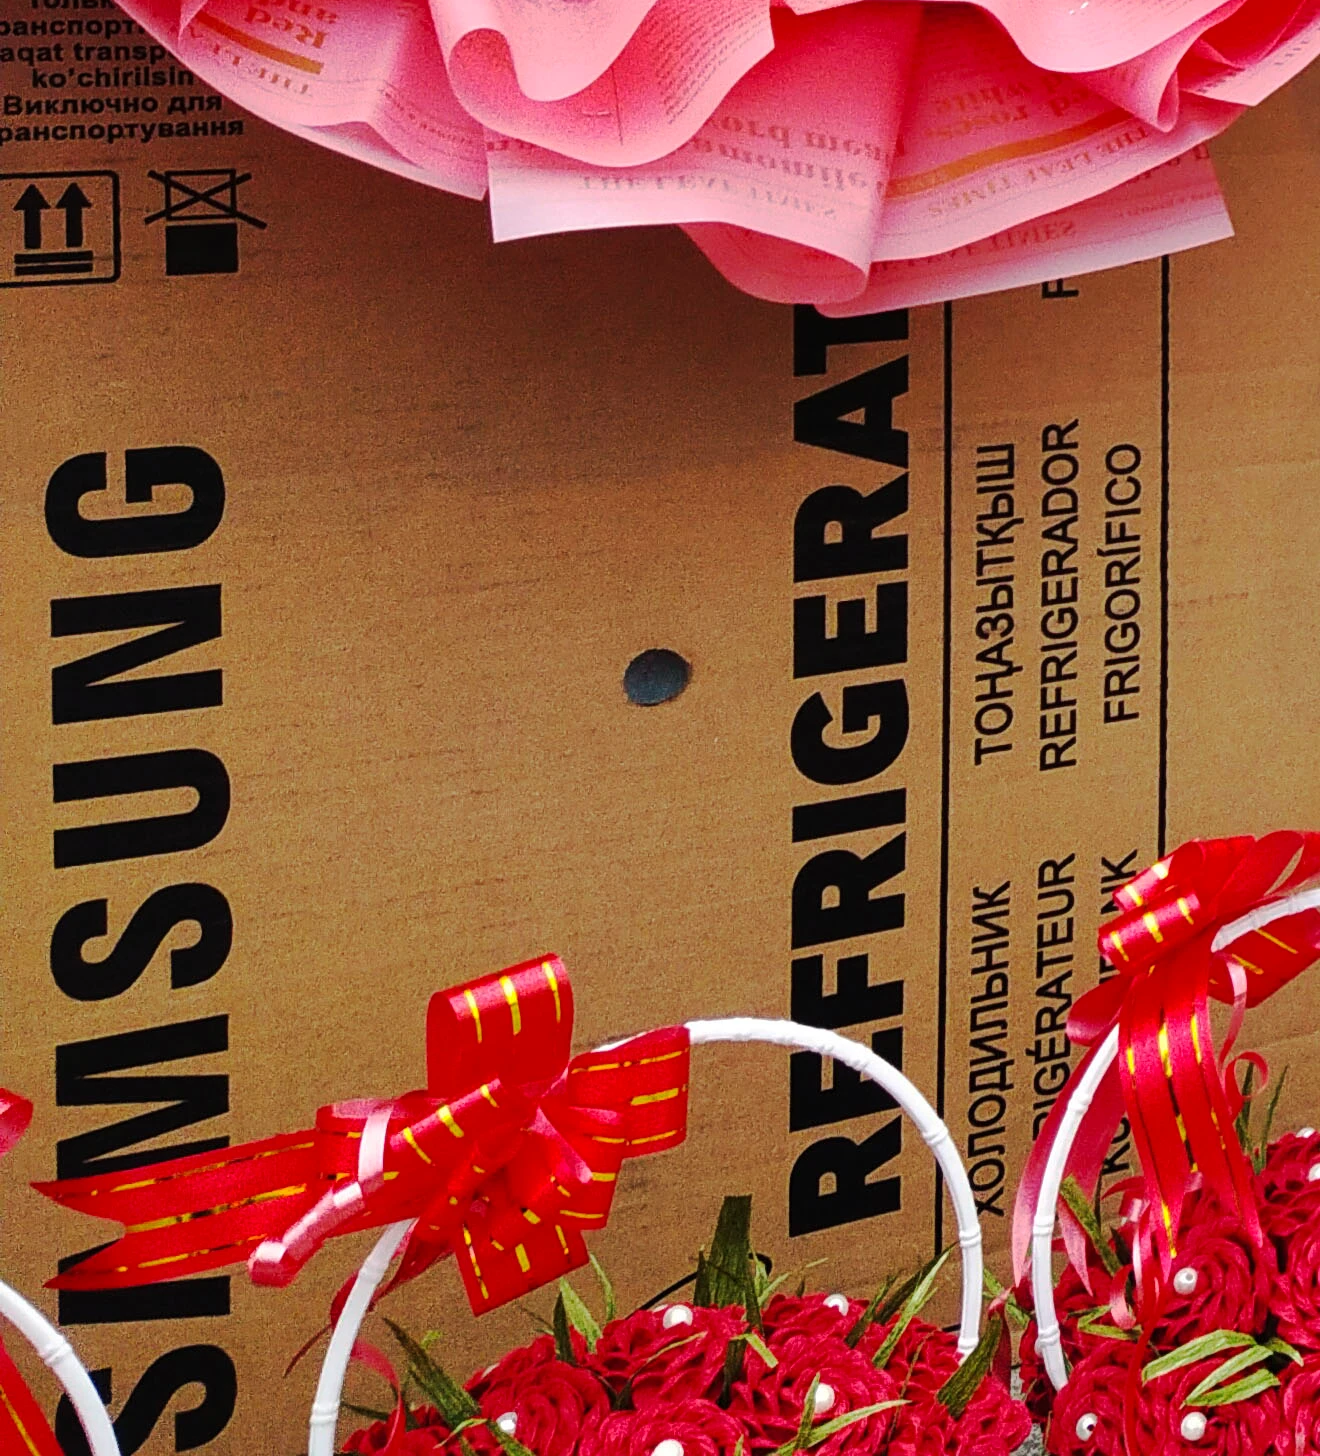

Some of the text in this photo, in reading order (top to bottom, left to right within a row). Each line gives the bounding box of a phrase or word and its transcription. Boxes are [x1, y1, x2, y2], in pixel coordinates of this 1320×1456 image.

[0, 18, 144, 40] анспорт
[3, 93, 223, 118] Виключно для
[1038, 417, 1081, 772] REFRIGERADOR
[1097, 441, 1143, 726] FRIGORÍFICO
[966, 879, 1013, 1219] ХОЛОДИЛЬНИК
